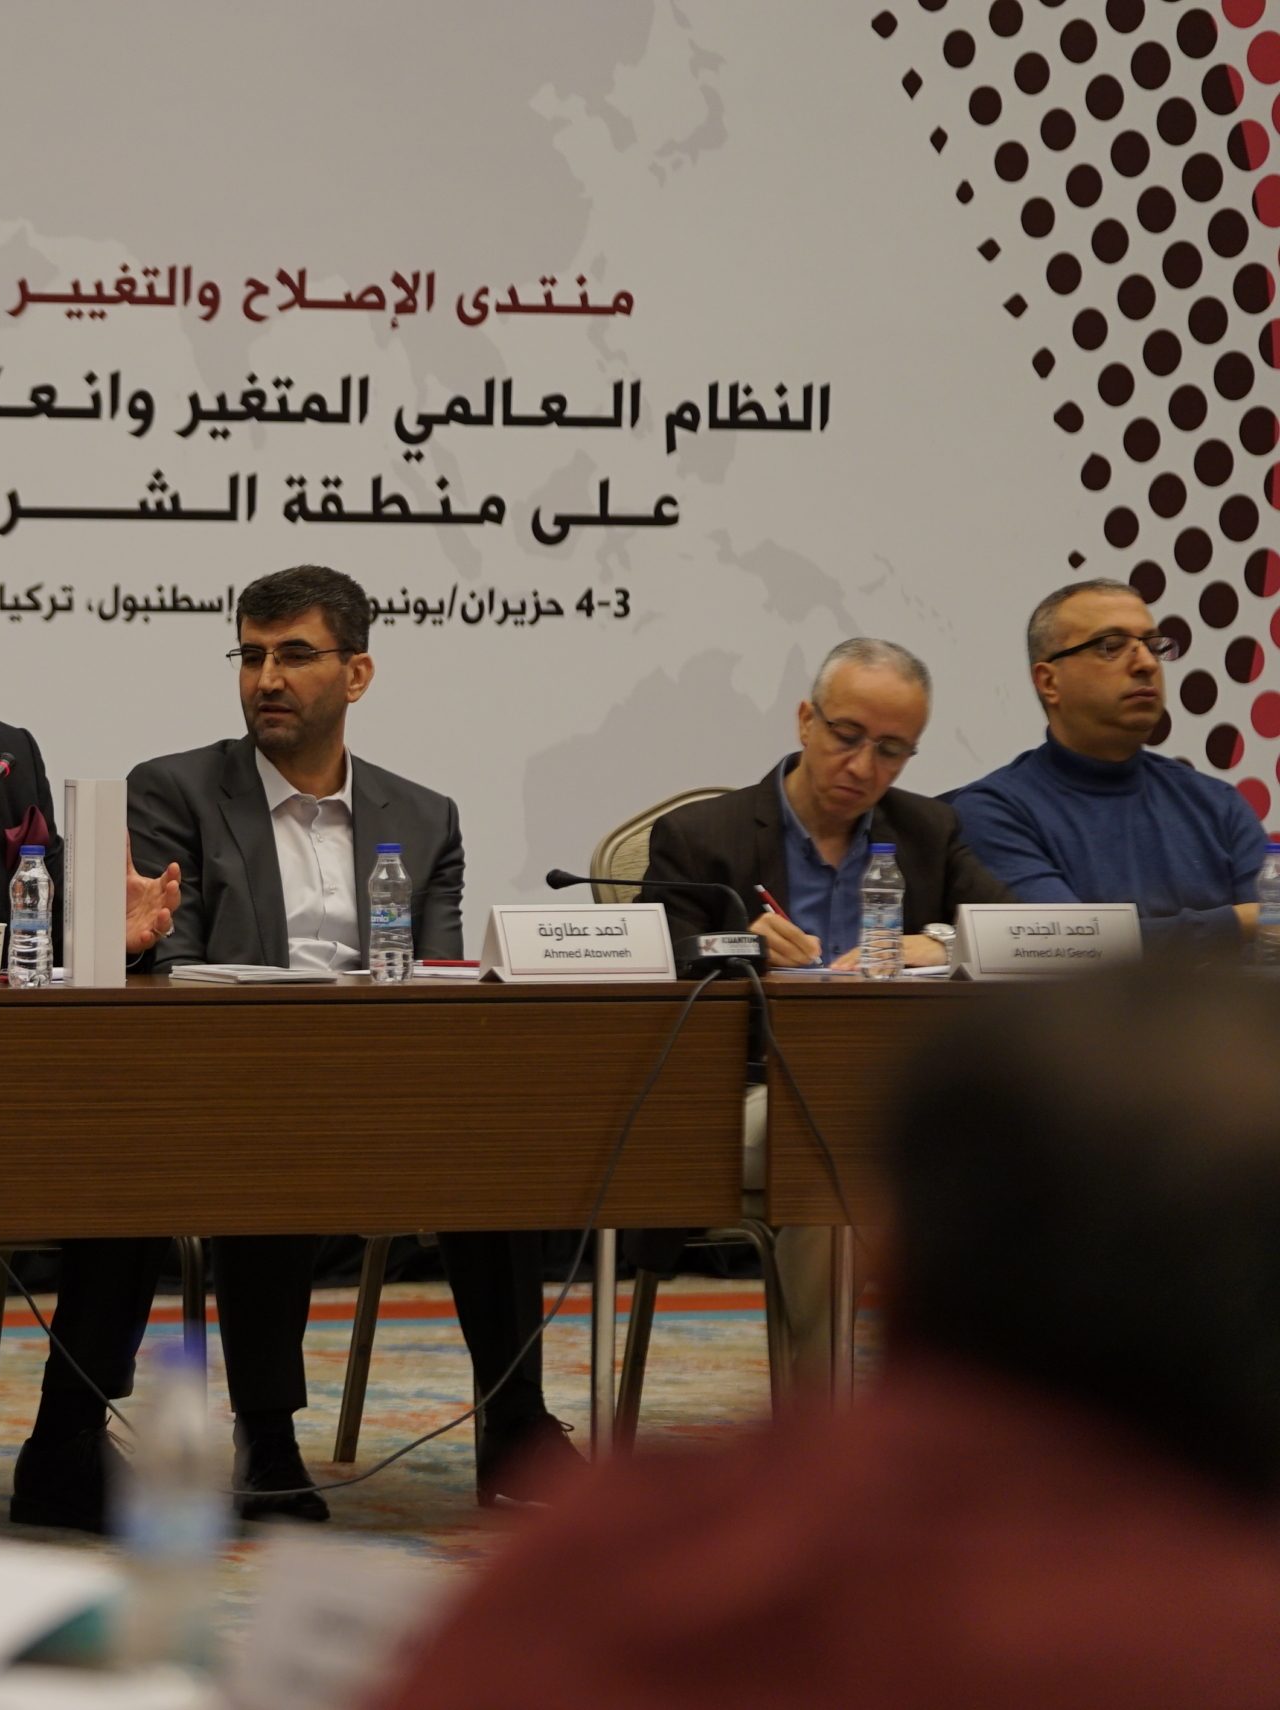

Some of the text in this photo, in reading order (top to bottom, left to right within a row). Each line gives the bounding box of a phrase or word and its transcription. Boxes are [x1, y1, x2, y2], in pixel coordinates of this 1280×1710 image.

[8, 264, 634, 328] منتدى الإصلاح والتغيير
[176, 373, 369, 440] المتغير
[394, 378, 641, 462] العالمي
[666, 382, 830, 454] النظام
[283, 475, 506, 525] منطقة
[531, 478, 679, 546] على
[0, 584, 73, 621] تركيا
[538, 917, 628, 941] أحمد عطاونة
[1009, 916, 1100, 940] أحمد الجندي
[1014, 947, 1053, 958] Ahmed
[544, 948, 632, 959] Ahmed Atawneh
